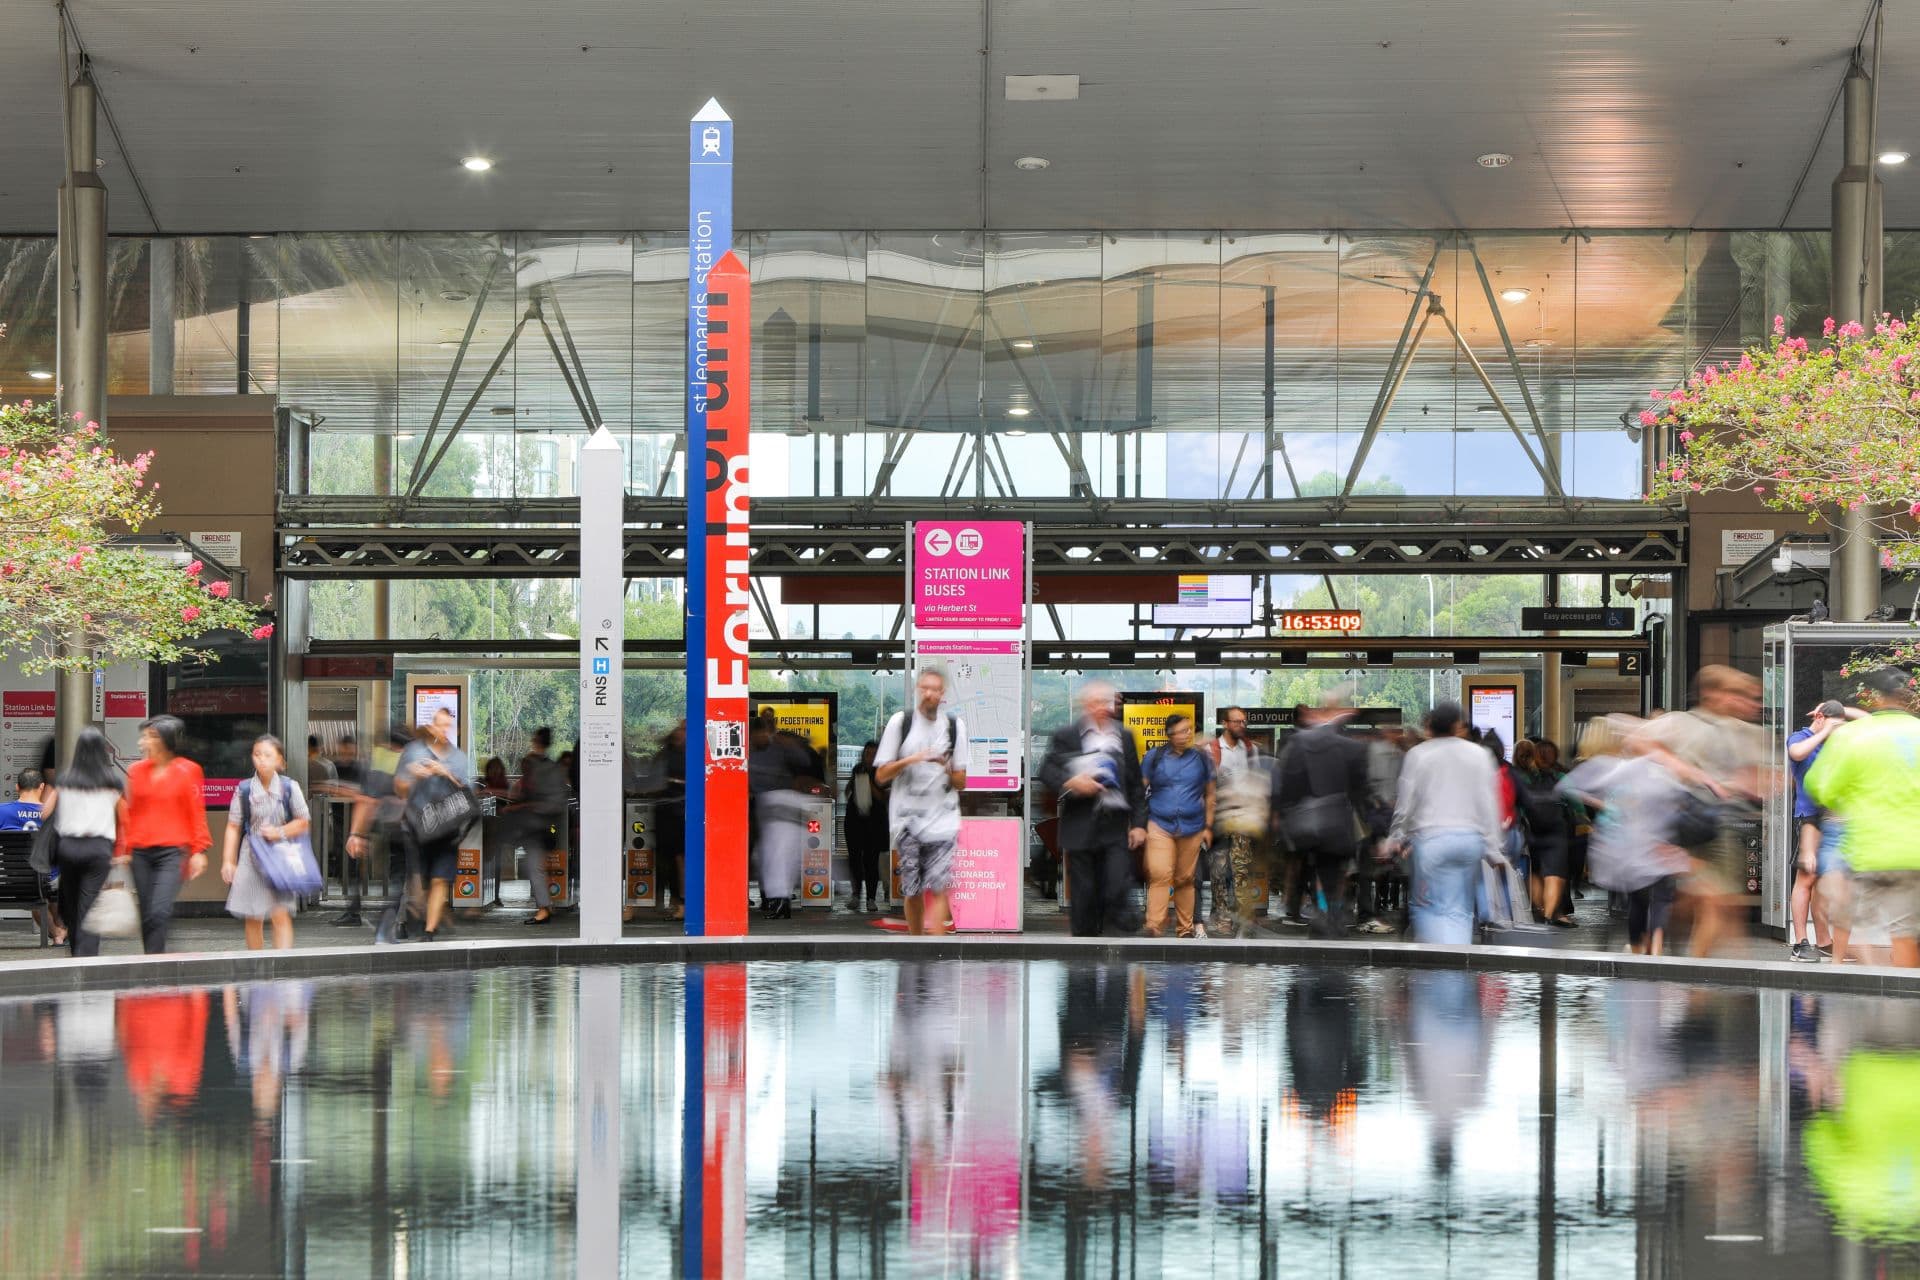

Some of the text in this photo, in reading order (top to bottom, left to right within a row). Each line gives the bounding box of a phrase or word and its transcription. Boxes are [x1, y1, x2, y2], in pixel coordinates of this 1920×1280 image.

[692, 211, 712, 284] station
[691, 292, 707, 385] leonards
[924, 567, 1010, 580] STATION LINK
[924, 584, 966, 597] BUSES
[924, 603, 977, 612] via Herbert St
[1543, 612, 1602, 621] Easy access gate
[1283, 615, 1361, 630] 16:53:09
[1626, 656, 1637, 670] 2
[596, 676, 607, 706] RNS
[4, 703, 30, 711] Station
[30, 703, 46, 711] Link
[780, 716, 824, 725] PEDESTRIANS
[1247, 711, 1290, 723] lan your
[1142, 728, 1156, 737] ARE
[17, 810, 44, 819] VARDY
[969, 849, 999, 857] HOURS
[958, 860, 975, 868] FOR
[951, 870, 993, 879] LEONARDS
[946, 881, 1006, 889] DAY TO FRIDAY
[954, 892, 976, 900] ONLY
